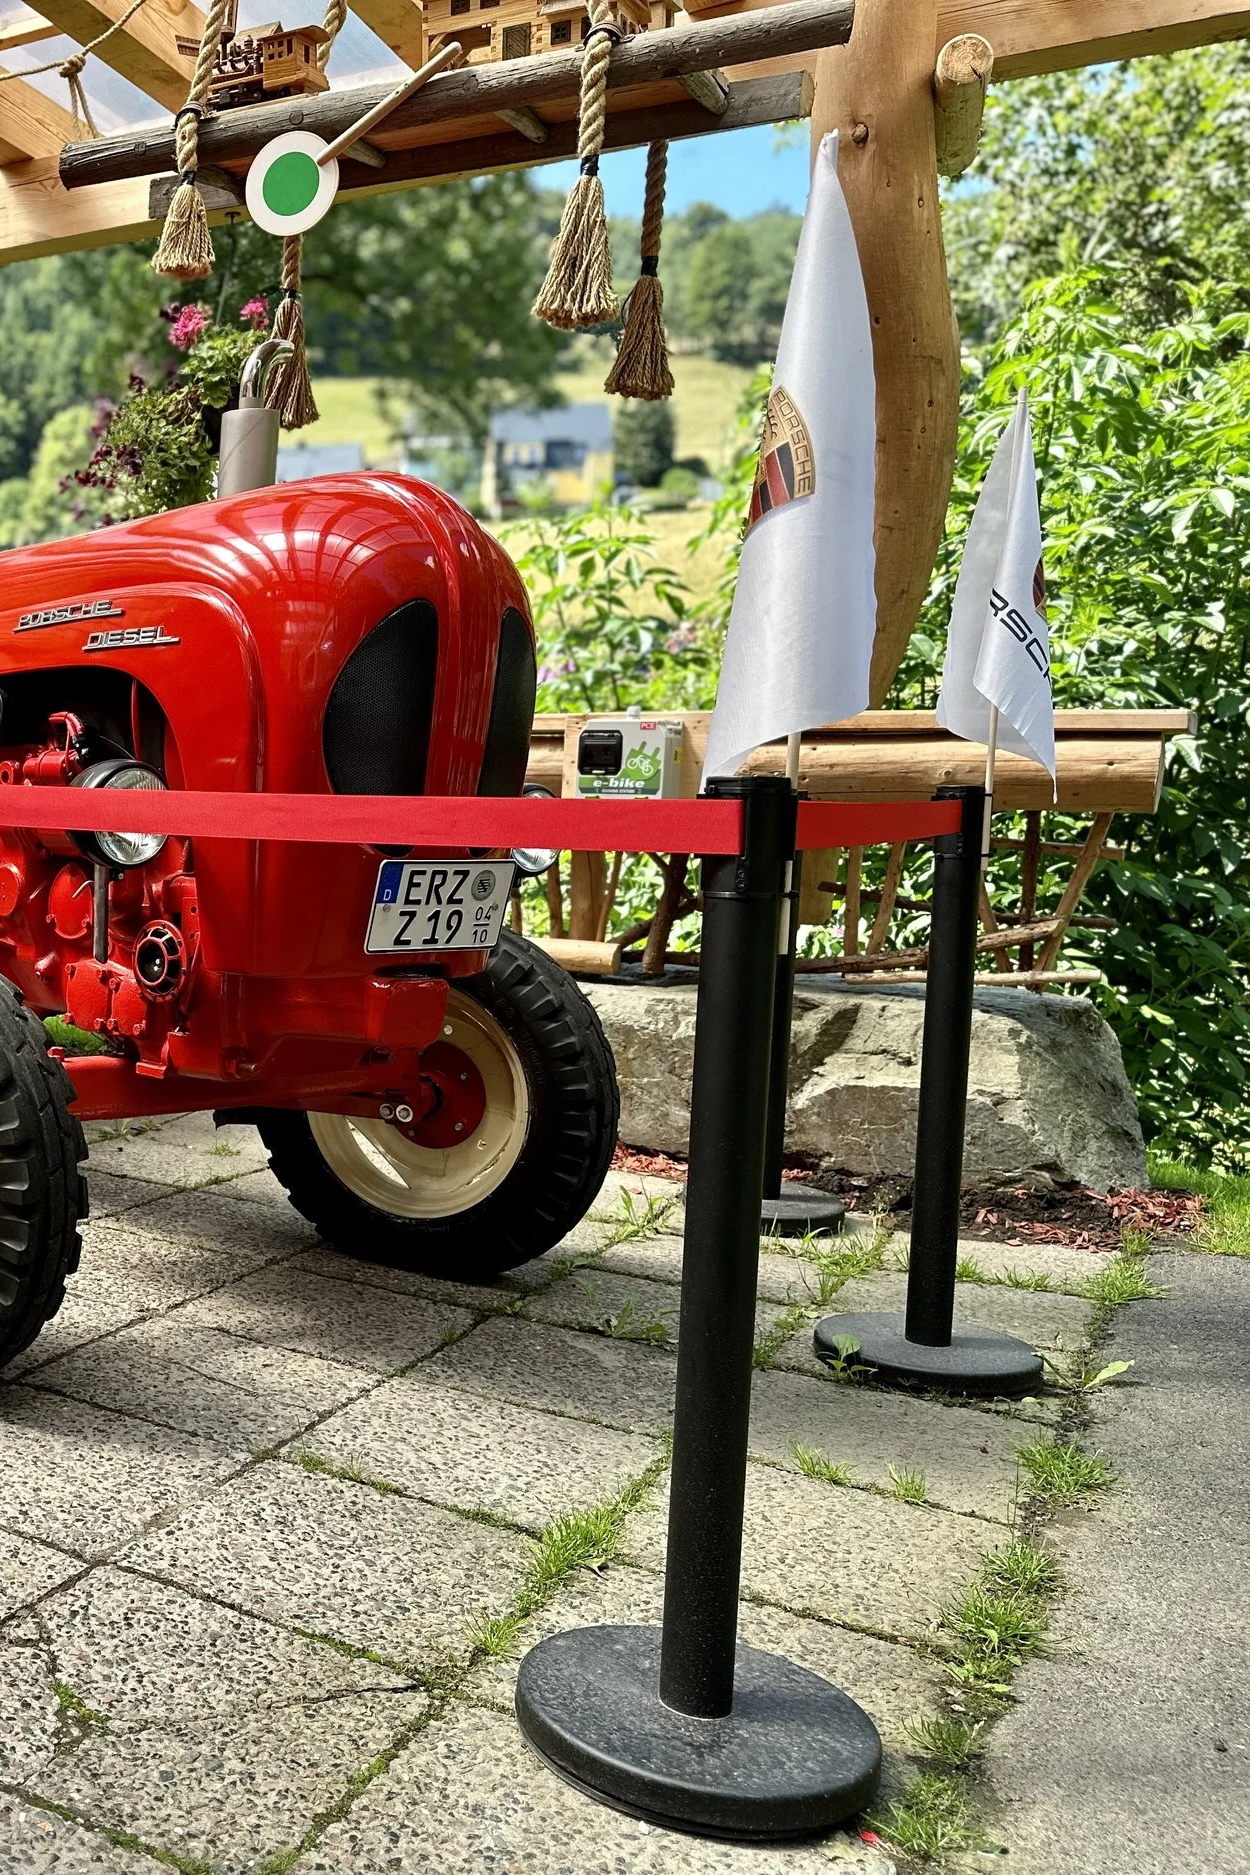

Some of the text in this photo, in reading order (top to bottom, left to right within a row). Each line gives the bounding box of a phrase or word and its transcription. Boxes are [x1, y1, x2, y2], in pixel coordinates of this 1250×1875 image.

[773, 389, 811, 494] PORSCHE
[17, 600, 116, 631] PORSCHE
[85, 625, 175, 649] DIESEL
[641, 722, 656, 730] PCE
[592, 777, 645, 788] e-bike
[383, 889, 392, 901] D
[403, 869, 471, 906] ERZ
[475, 906, 492, 922] 04
[393, 909, 464, 946] Z 19
[472, 929, 488, 944] 10
